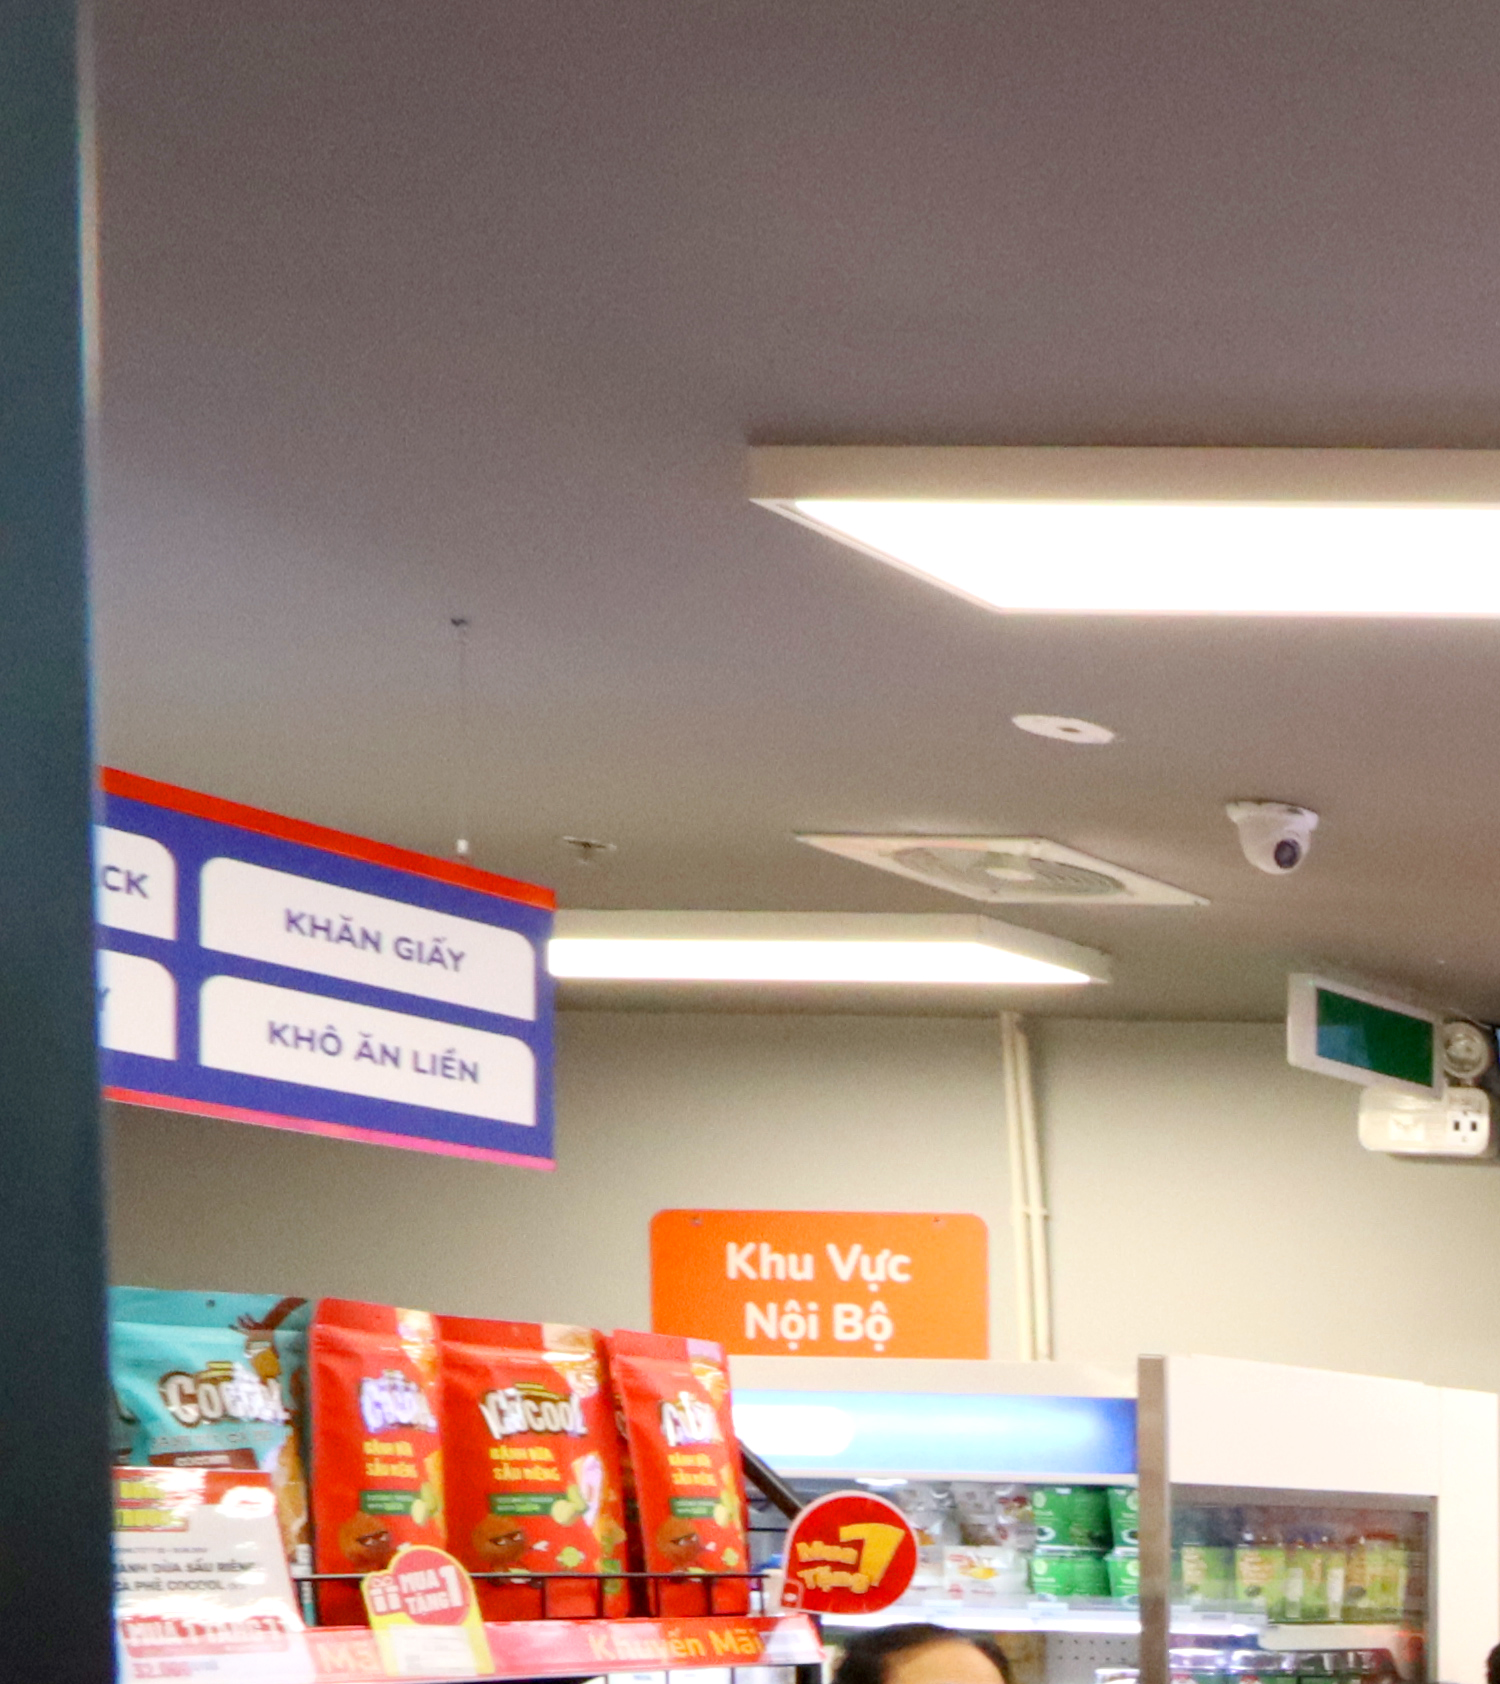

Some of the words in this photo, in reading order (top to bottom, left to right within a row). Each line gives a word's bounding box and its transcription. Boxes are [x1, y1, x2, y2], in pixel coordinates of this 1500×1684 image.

[283, 906, 383, 956] KHĂN
[391, 932, 467, 975] GIẤY
[267, 1016, 344, 1060] KHÔ
[353, 1033, 402, 1071] ĂN
[726, 1242, 815, 1282] Khu
[828, 1242, 911, 1290] Vực
[744, 1302, 820, 1345] Nội
[833, 1302, 894, 1345] Bộ
[589, 1629, 705, 1659] Khuyến
[711, 1627, 764, 1656] Mãi
